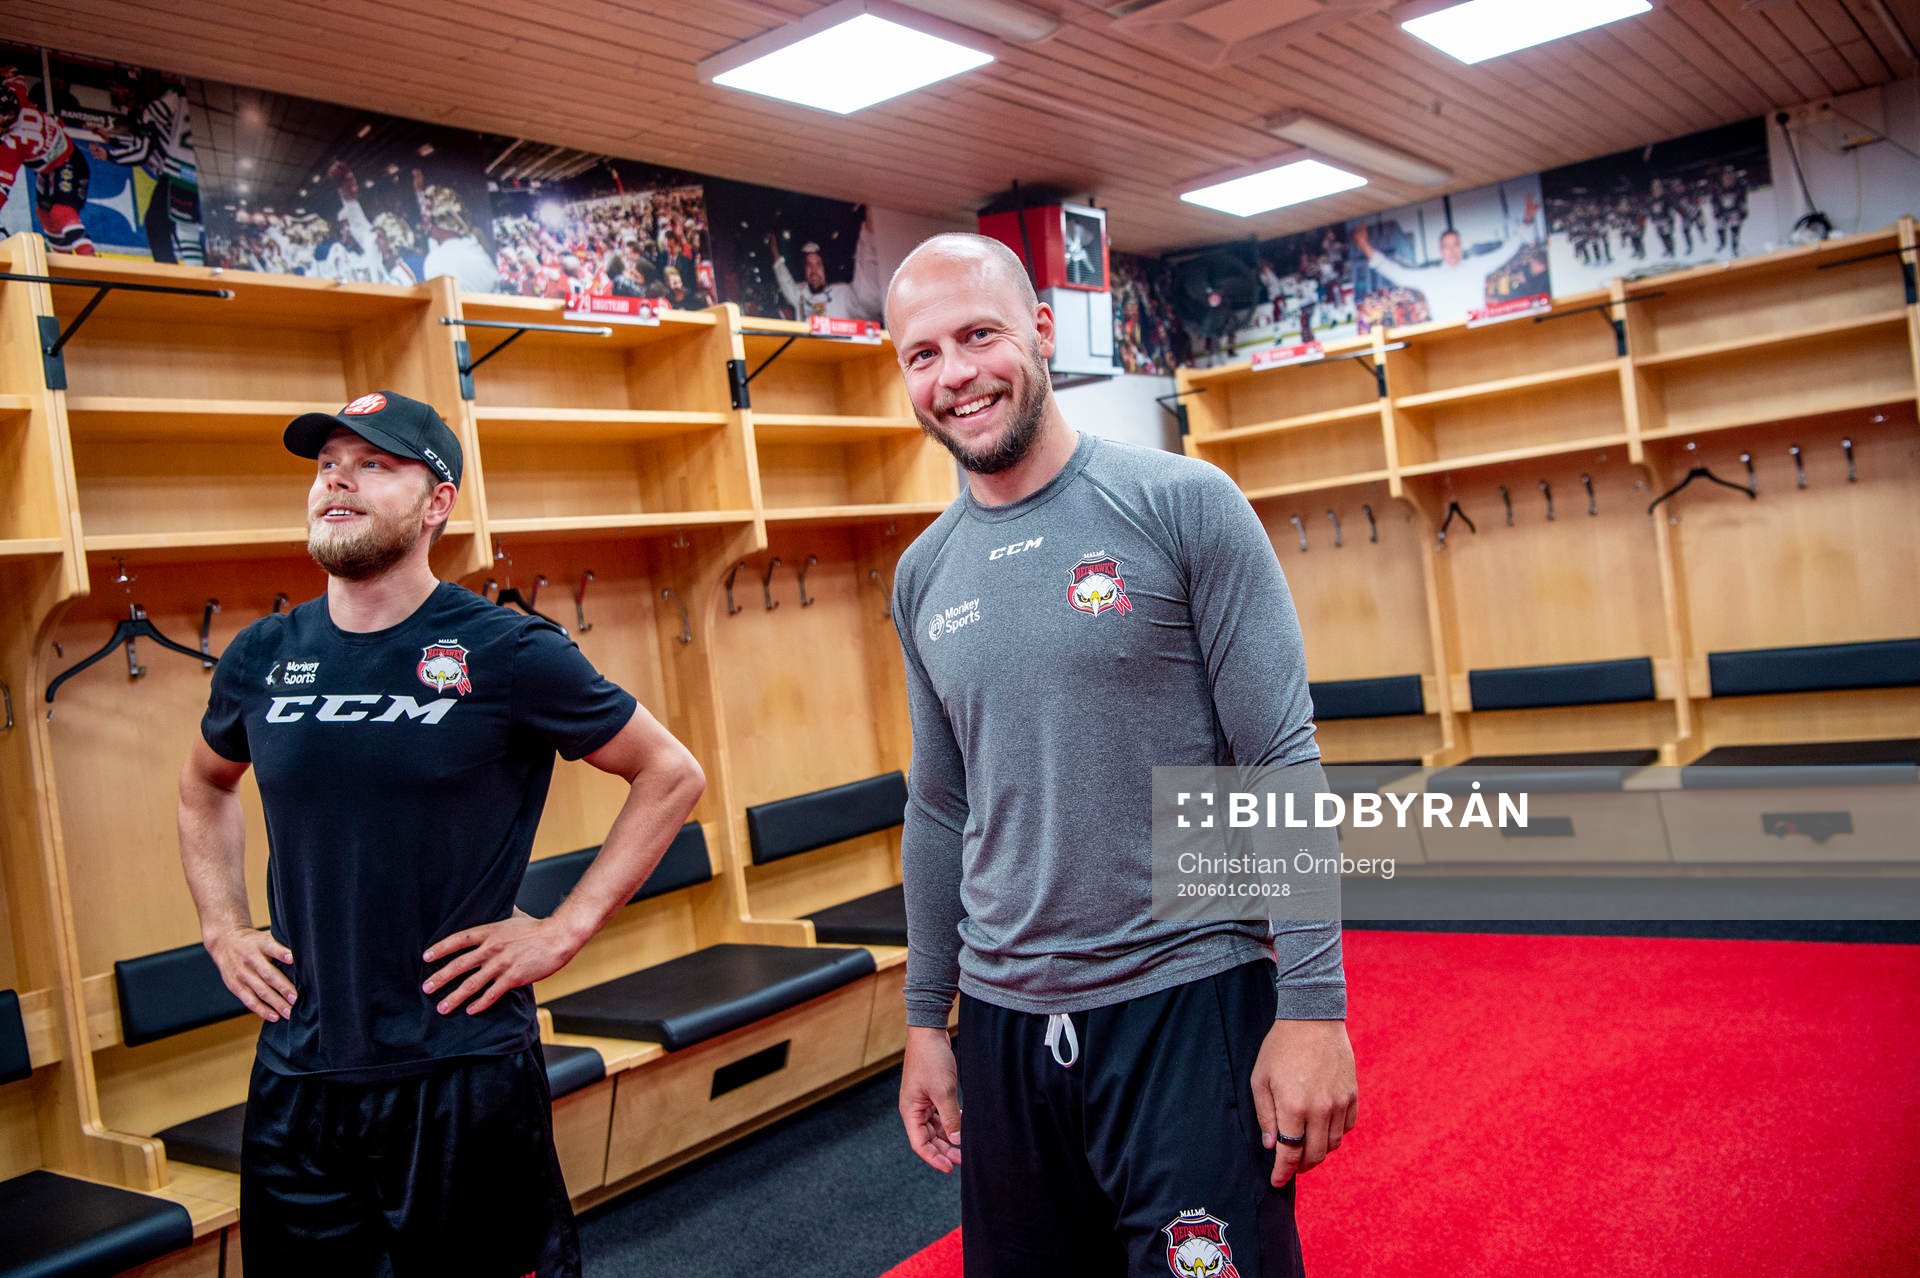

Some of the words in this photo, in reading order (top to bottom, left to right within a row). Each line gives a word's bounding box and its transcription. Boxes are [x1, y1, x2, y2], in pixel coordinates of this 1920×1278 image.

[988, 536, 1045, 561] CCM
[945, 598, 979, 620] Monkey
[945, 610, 981, 633] Sports
[283, 671, 316, 685] Sports
[286, 661, 320, 673] Monkey
[265, 693, 458, 725] CCM
